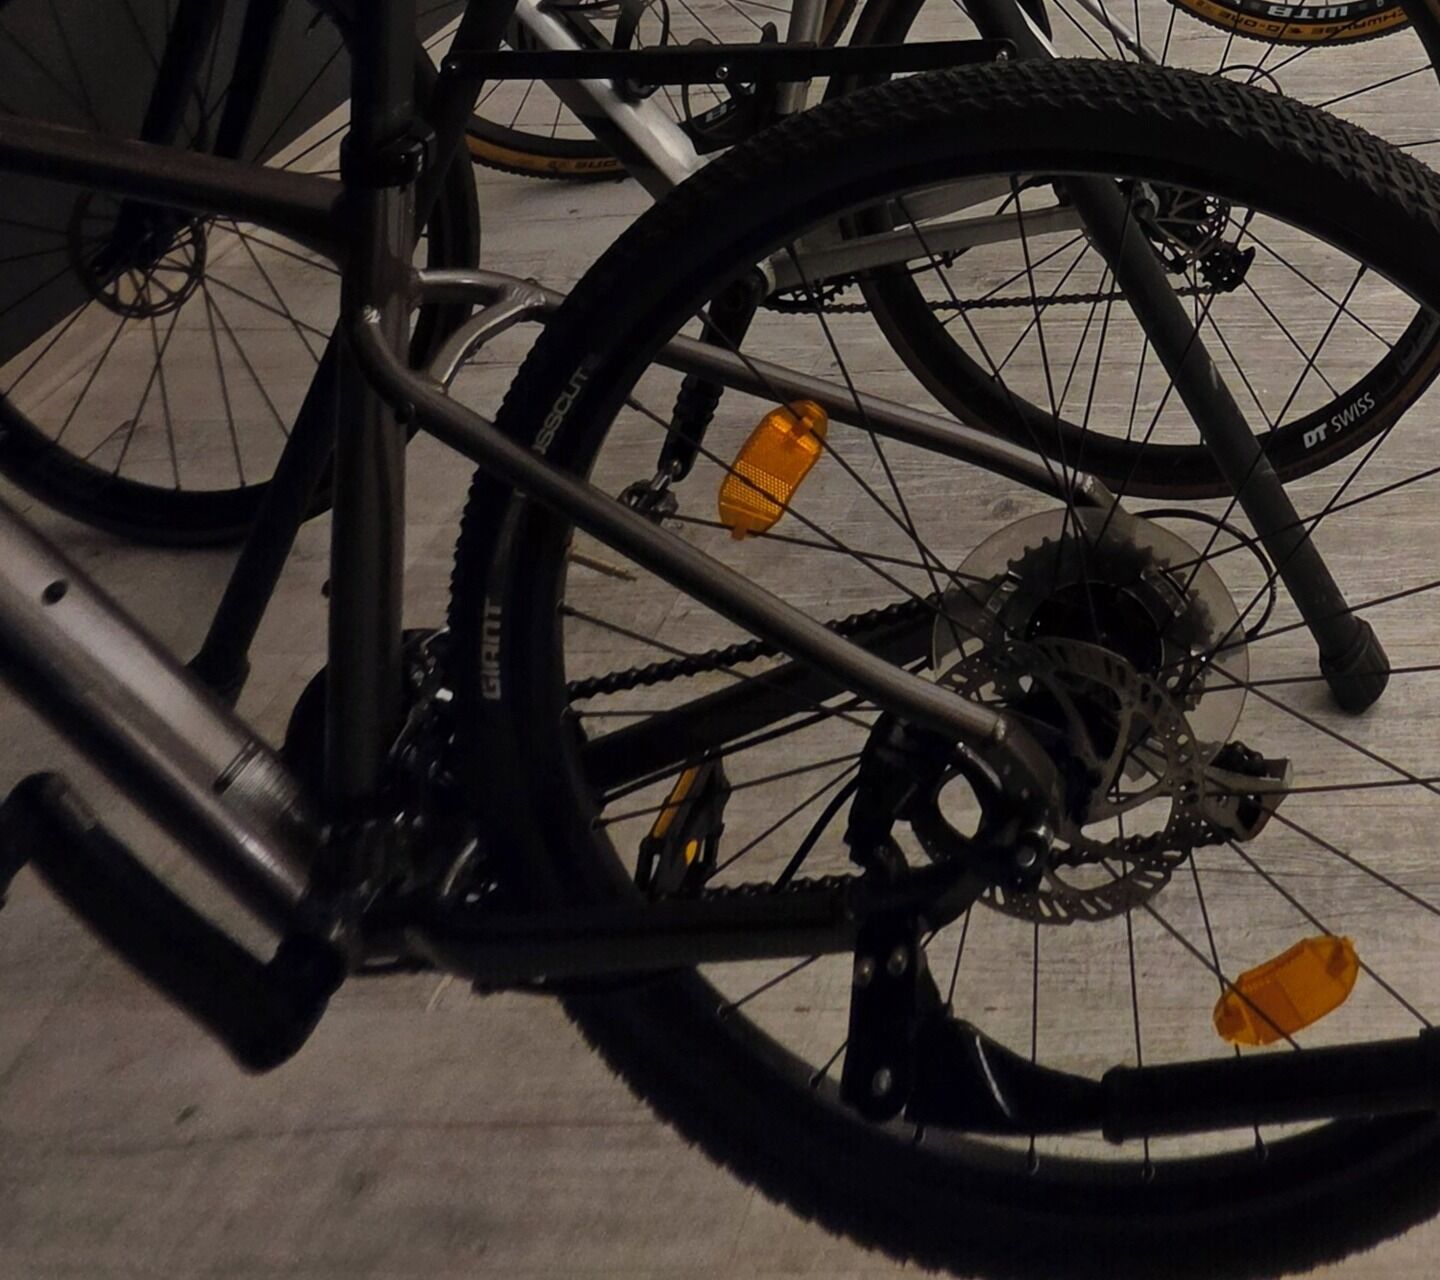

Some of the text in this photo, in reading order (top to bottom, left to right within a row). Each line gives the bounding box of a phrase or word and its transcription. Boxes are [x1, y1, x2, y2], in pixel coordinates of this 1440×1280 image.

[1266, 4, 1349, 20] WTB
[1309, 9, 1404, 35] CHWALBE
[1302, 391, 1376, 449] DT SWISS
[480, 597, 502, 701] GIANT
